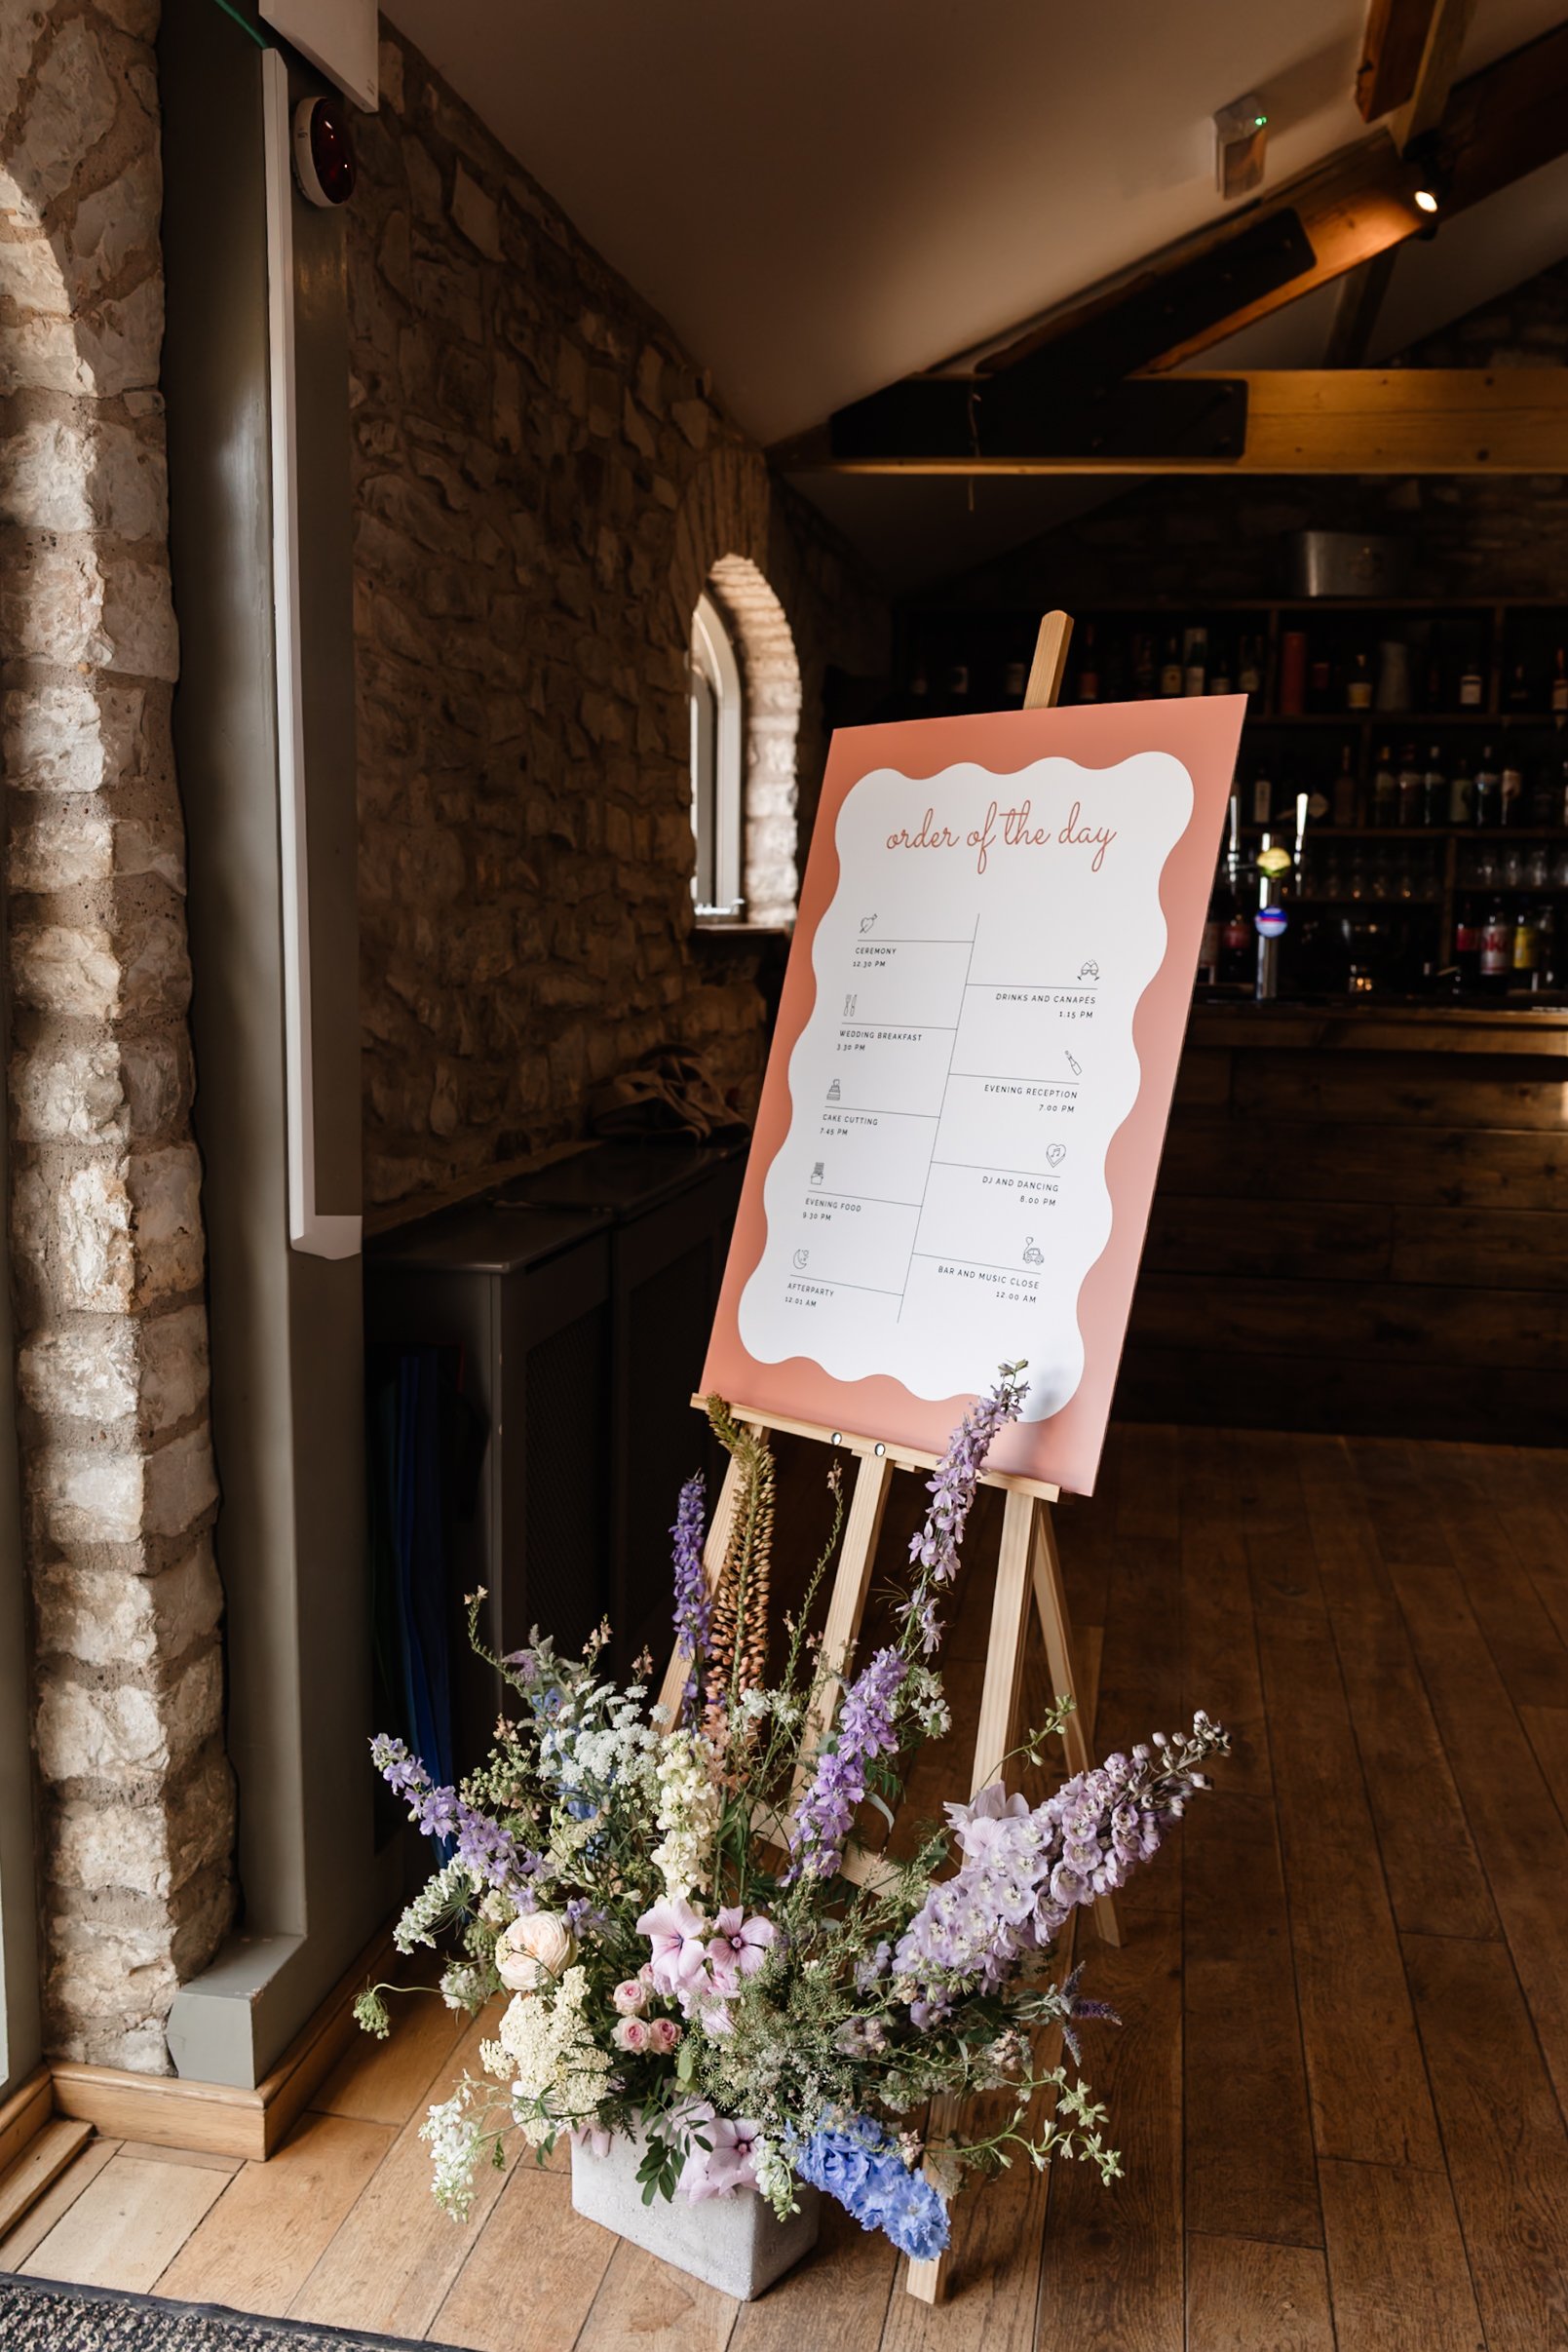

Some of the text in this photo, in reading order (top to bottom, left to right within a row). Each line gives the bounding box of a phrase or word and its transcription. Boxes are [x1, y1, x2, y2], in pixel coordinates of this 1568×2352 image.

[886, 800, 1117, 874] order of the day
[855, 946, 897, 955] CEREMONY
[995, 992, 1028, 1002] DRINKS
[1031, 994, 1050, 1003] AND
[839, 1030, 922, 1042] WEDDING BREAKFAST
[984, 1084, 1078, 1099] EVENING RECEPTION
[822, 1114, 878, 1126] CAKE CUTTING
[982, 1176, 1059, 1192] DJ AND DANCING
[805, 1198, 861, 1213] EVENING FOOD
[1043, 1198, 1055, 1207] PM
[937, 1265, 1040, 1290] BAR AND MUSIC CLOSE
[787, 1283, 834, 1296] AFTERPARTY
[1022, 1294, 1037, 1303] AM
